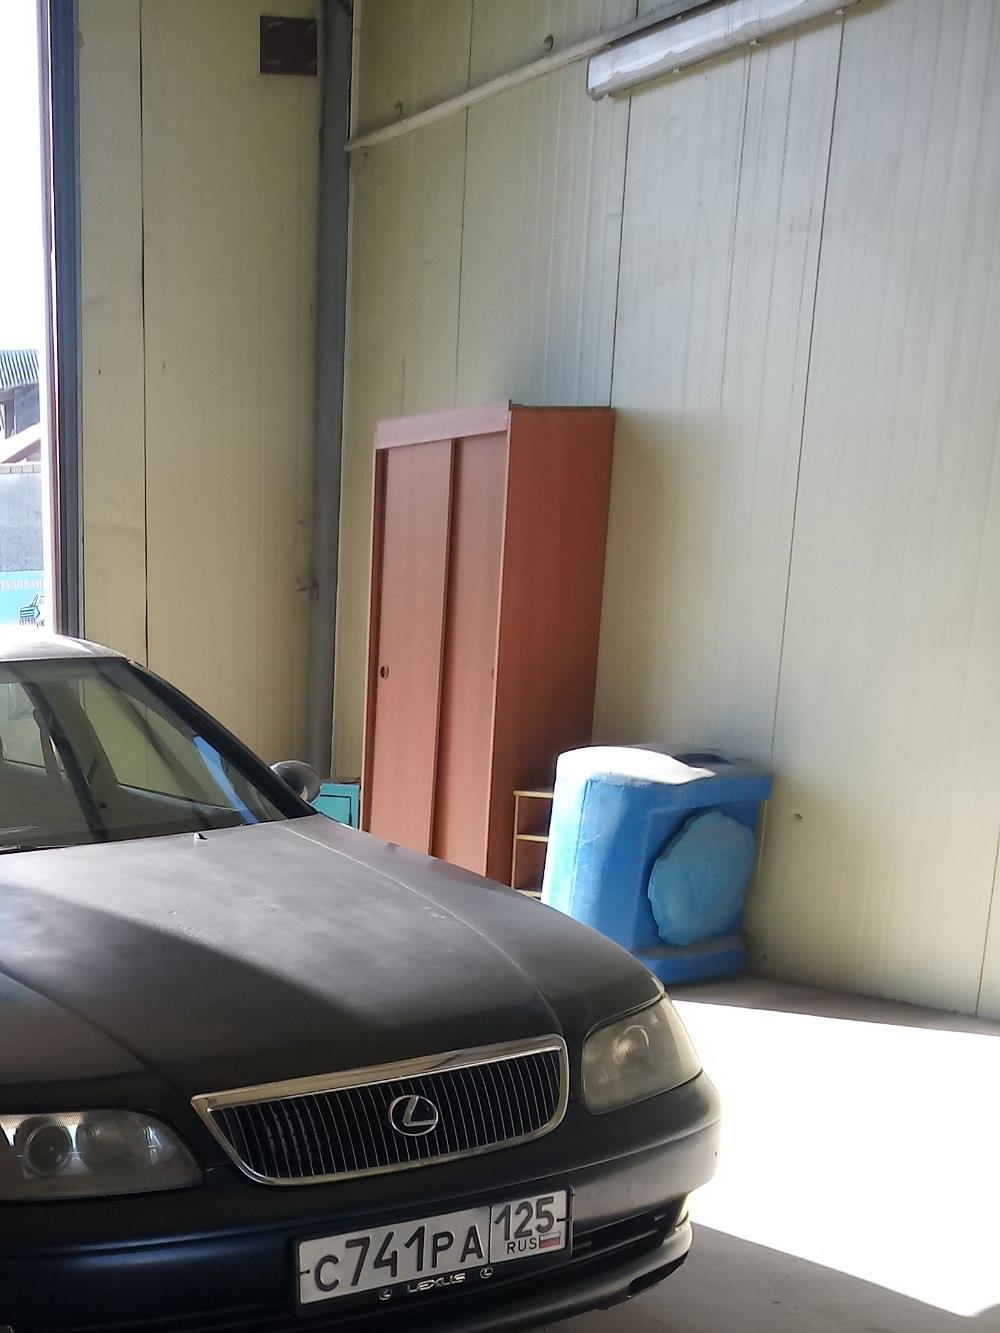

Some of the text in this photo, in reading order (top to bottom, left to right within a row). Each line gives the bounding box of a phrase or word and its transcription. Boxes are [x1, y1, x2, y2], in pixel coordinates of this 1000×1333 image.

[314, 1197, 555, 1293] С741РА 125
[506, 1239, 538, 1254] RUS
[407, 1272, 466, 1293] LEXUS
